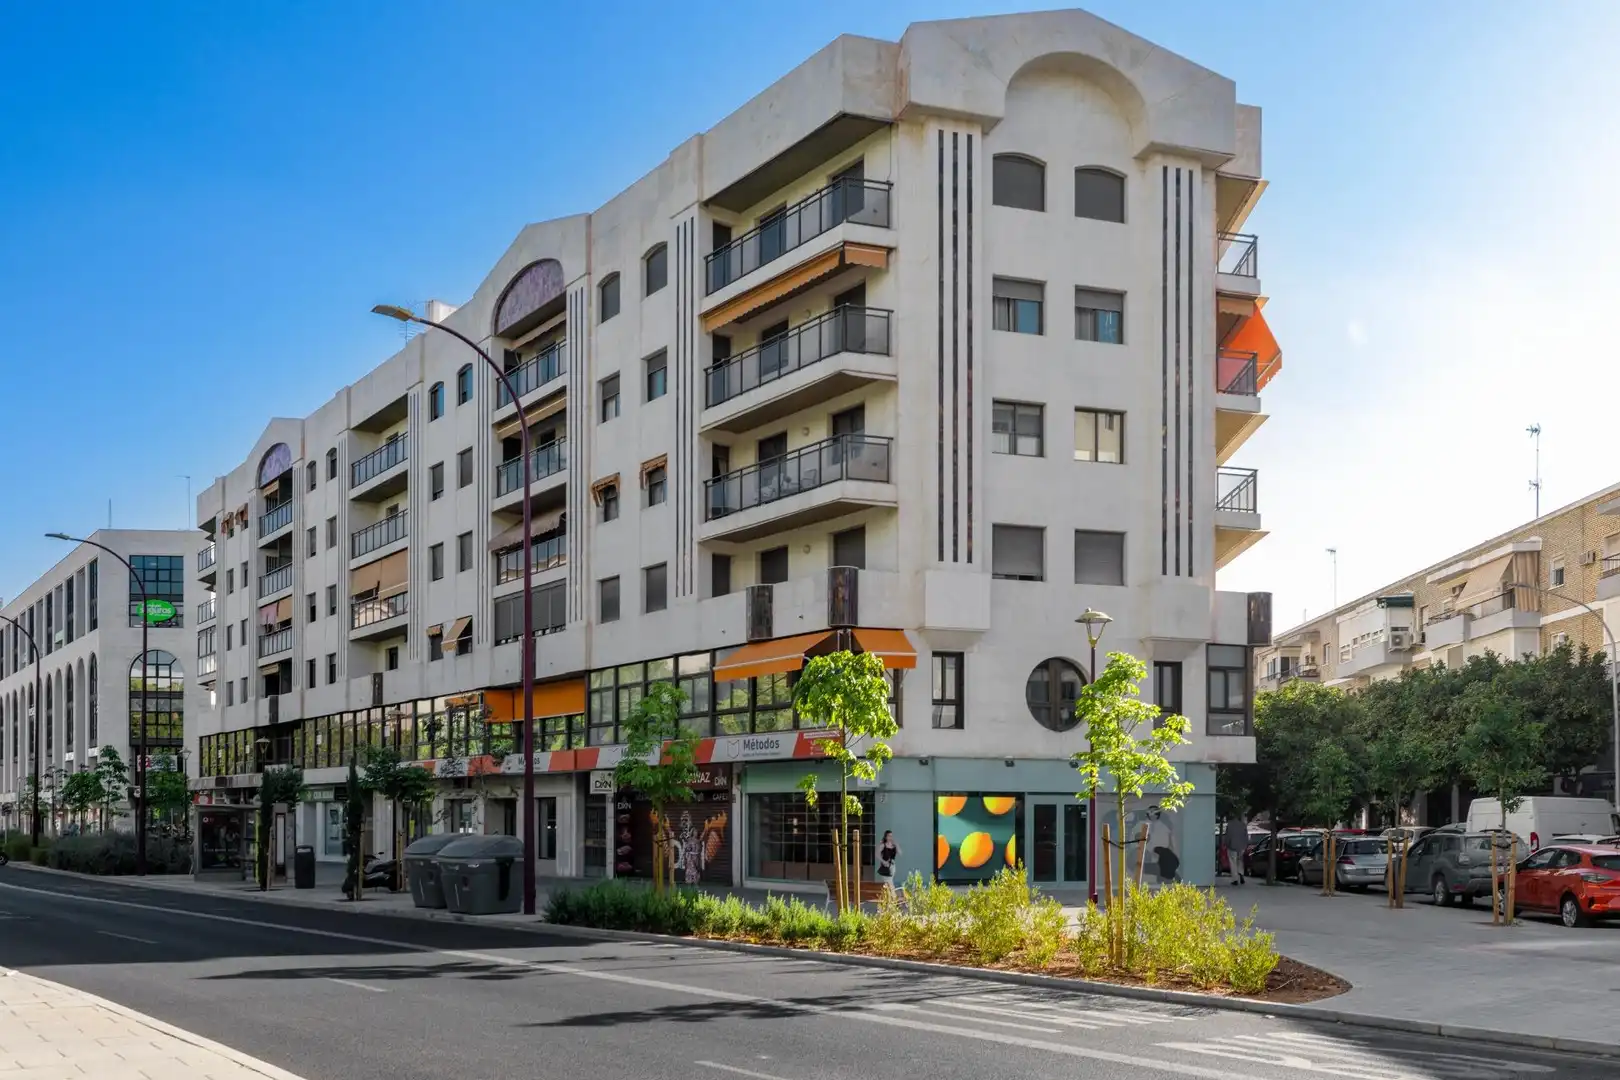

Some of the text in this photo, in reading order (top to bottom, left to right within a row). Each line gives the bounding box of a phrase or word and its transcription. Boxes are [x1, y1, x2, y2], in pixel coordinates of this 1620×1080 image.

[743, 738, 780, 751] Métodos
[594, 780, 612, 789] DXN
[617, 802, 632, 810] DXN
